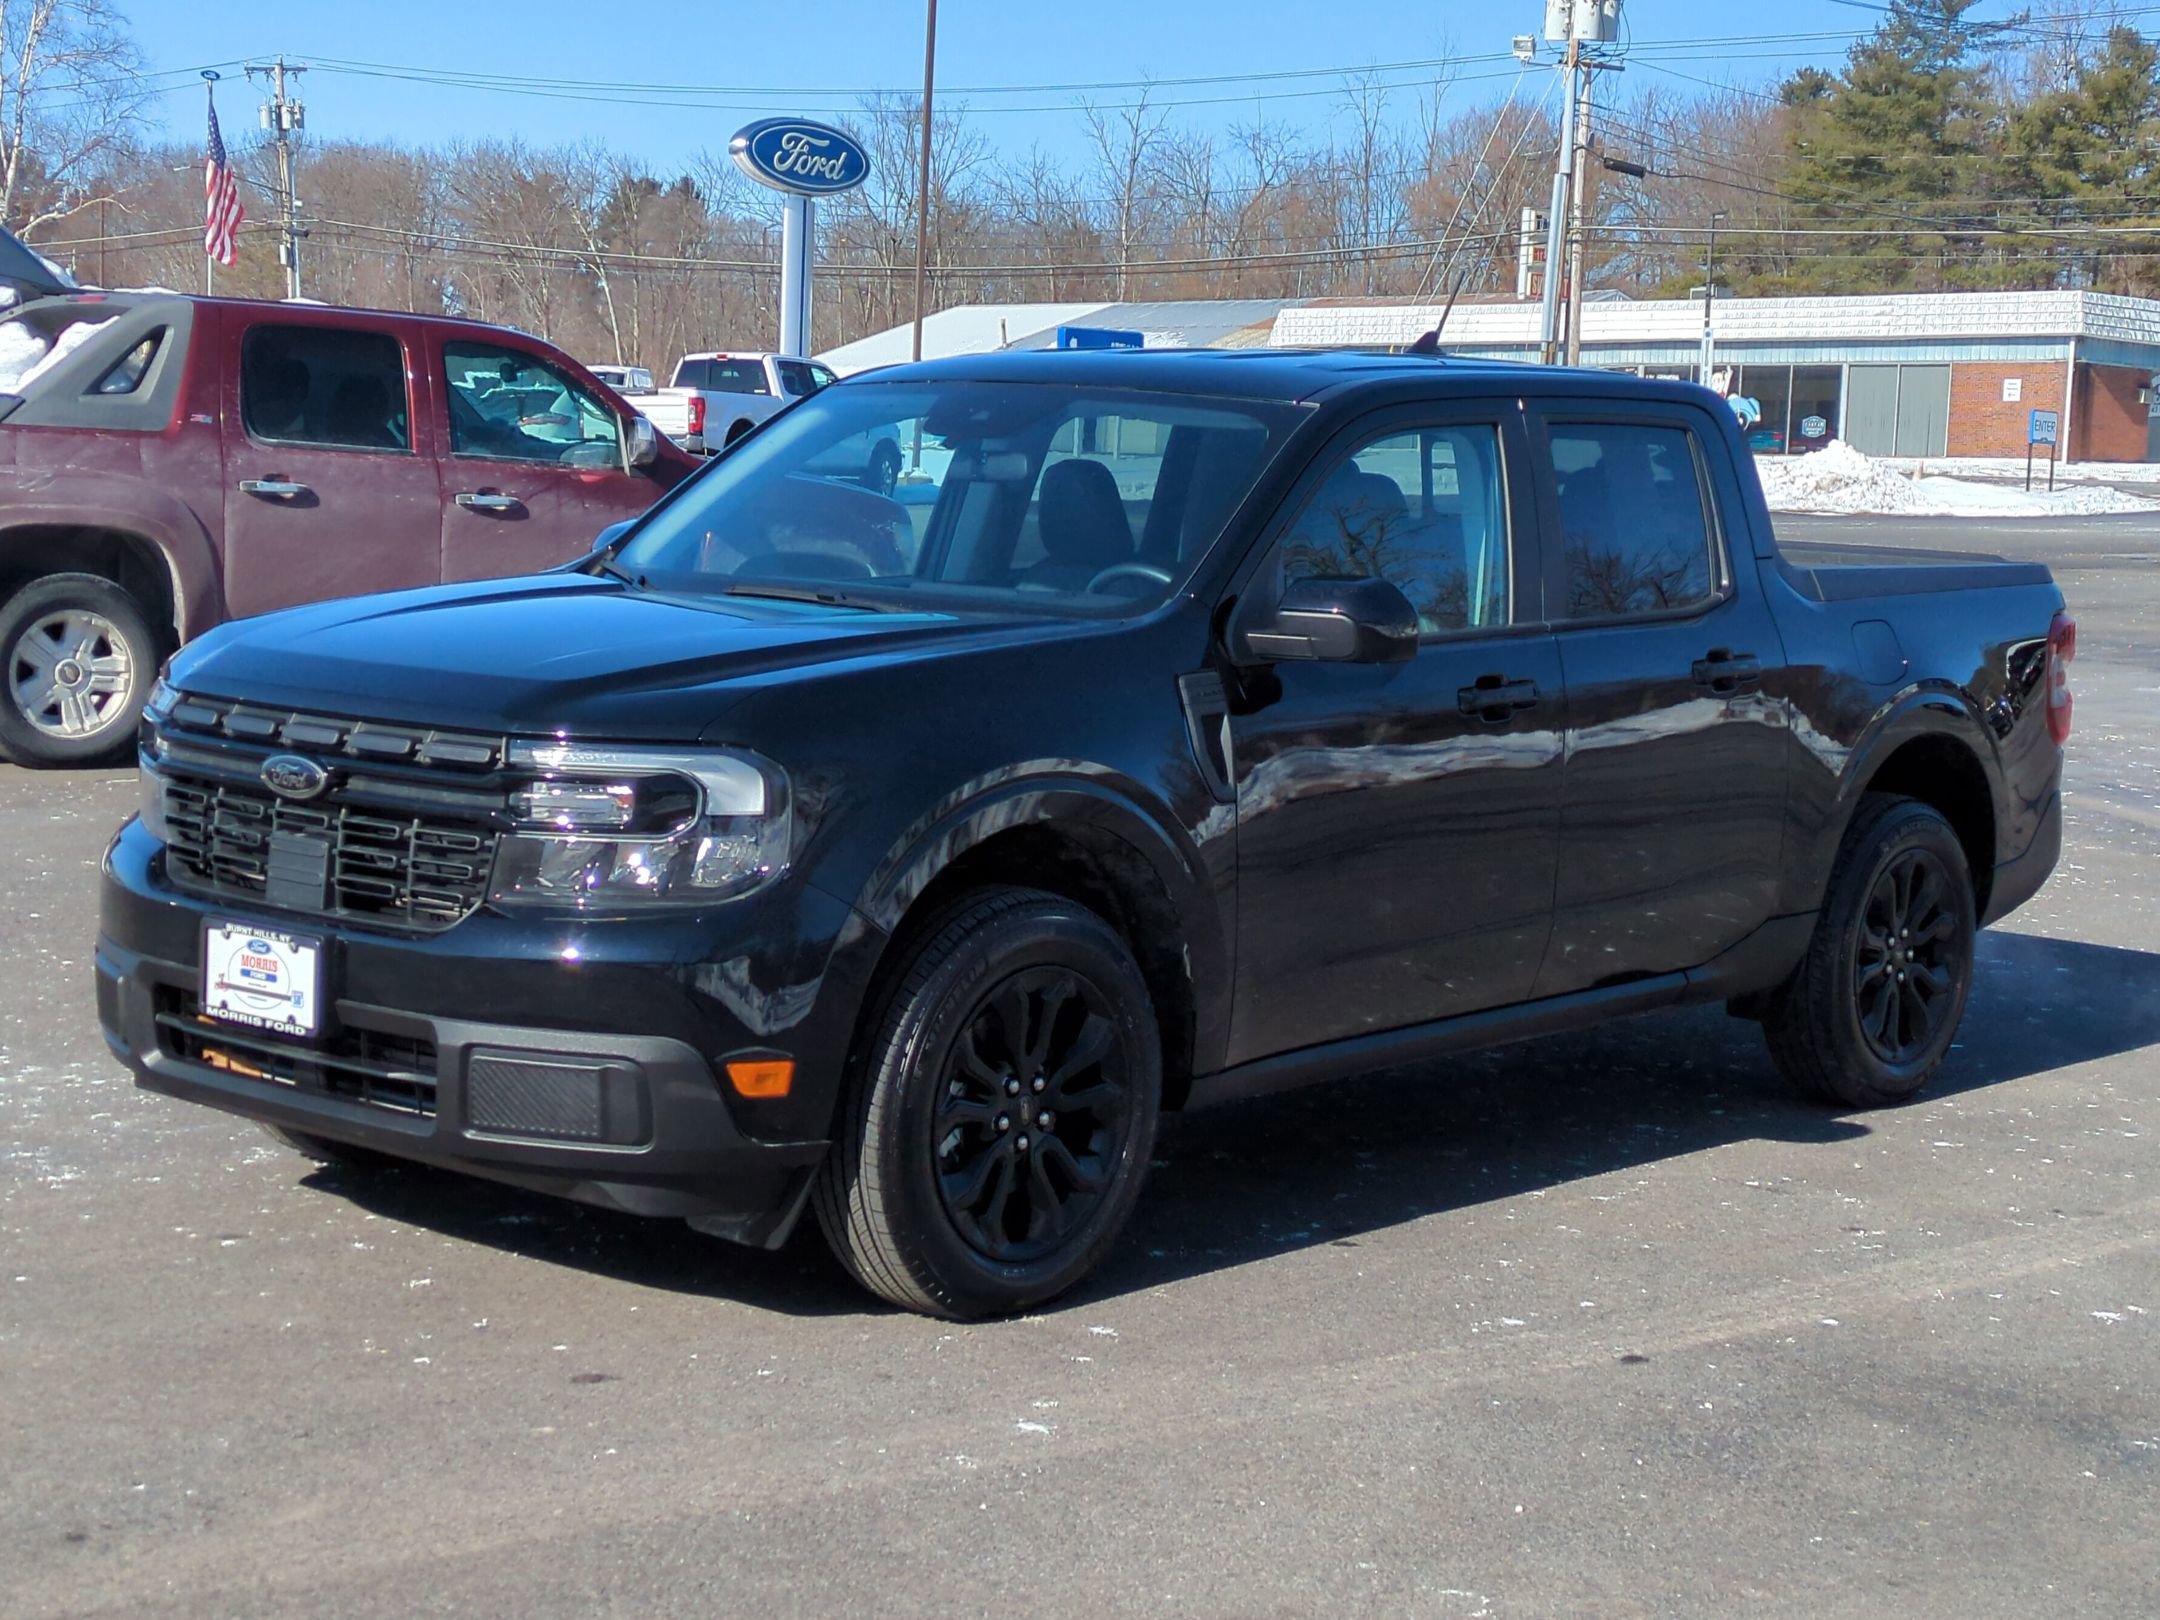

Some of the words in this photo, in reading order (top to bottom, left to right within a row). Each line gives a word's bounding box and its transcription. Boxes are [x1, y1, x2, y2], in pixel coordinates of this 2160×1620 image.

[773, 132, 848, 180] Ford
[2034, 419, 2056, 433] ENTER
[271, 762, 308, 788] Ford
[225, 922, 253, 937] BURNT
[241, 954, 278, 973] MORRIS
[206, 1006, 263, 1027] MORRIS
[264, 1019, 307, 1037] FORD
